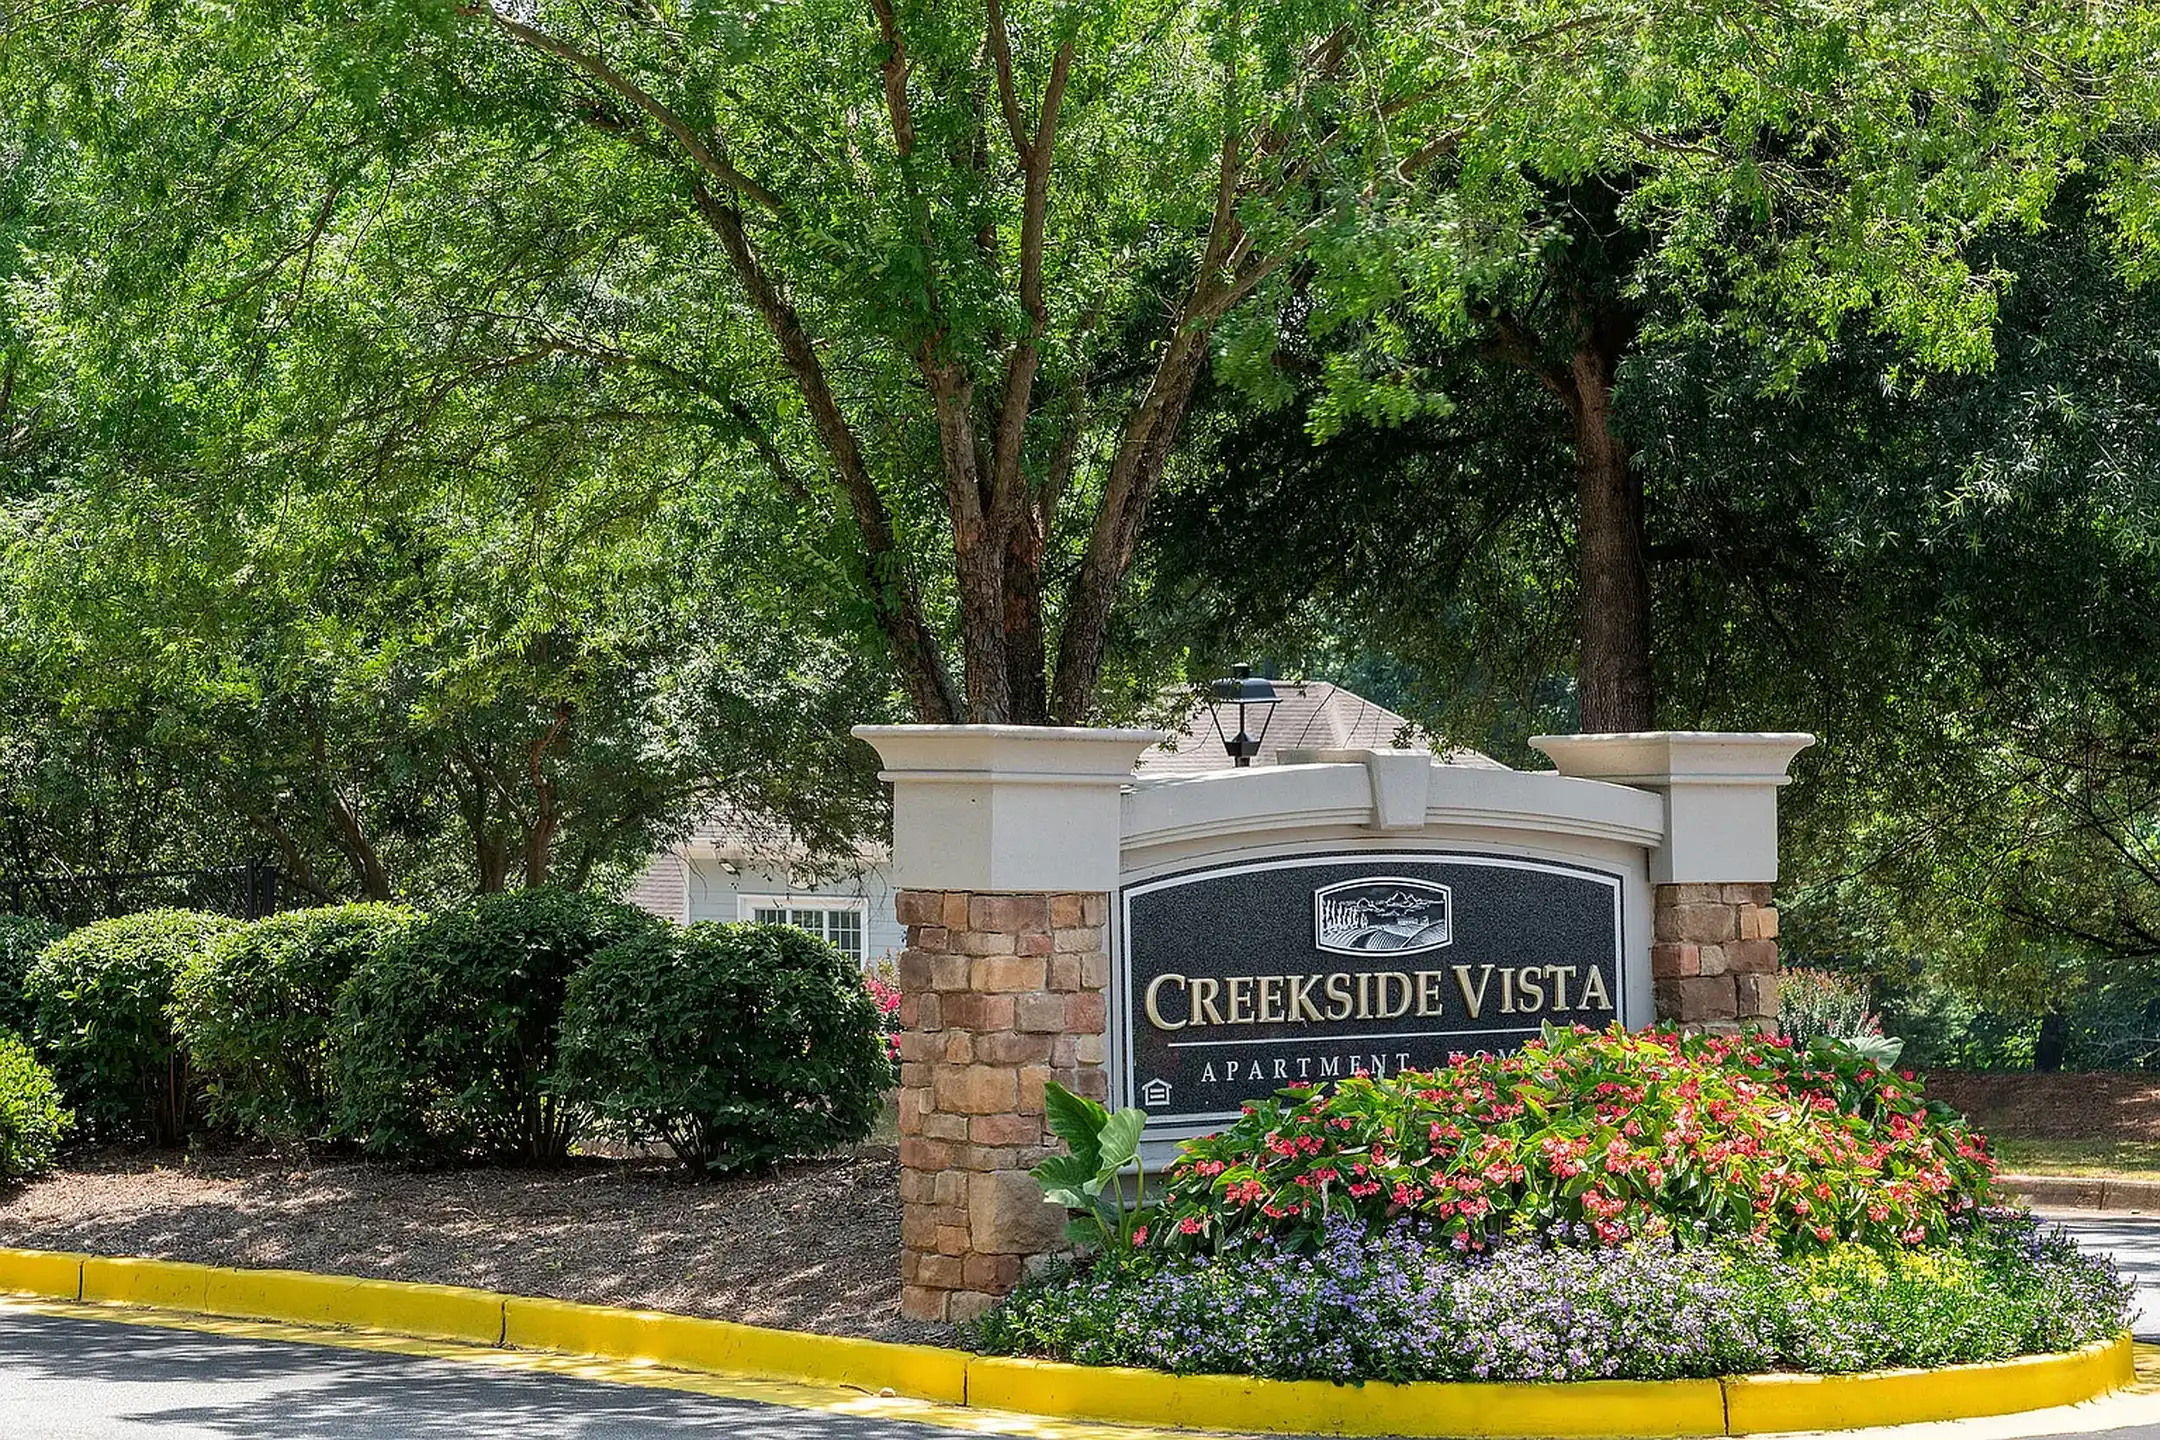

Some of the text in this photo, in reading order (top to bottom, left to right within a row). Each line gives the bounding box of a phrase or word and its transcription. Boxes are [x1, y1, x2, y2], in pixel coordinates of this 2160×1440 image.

[1144, 963, 1614, 1031] CREEKSIDE VISTA
[1200, 1052, 1410, 1083] APARTMENT
